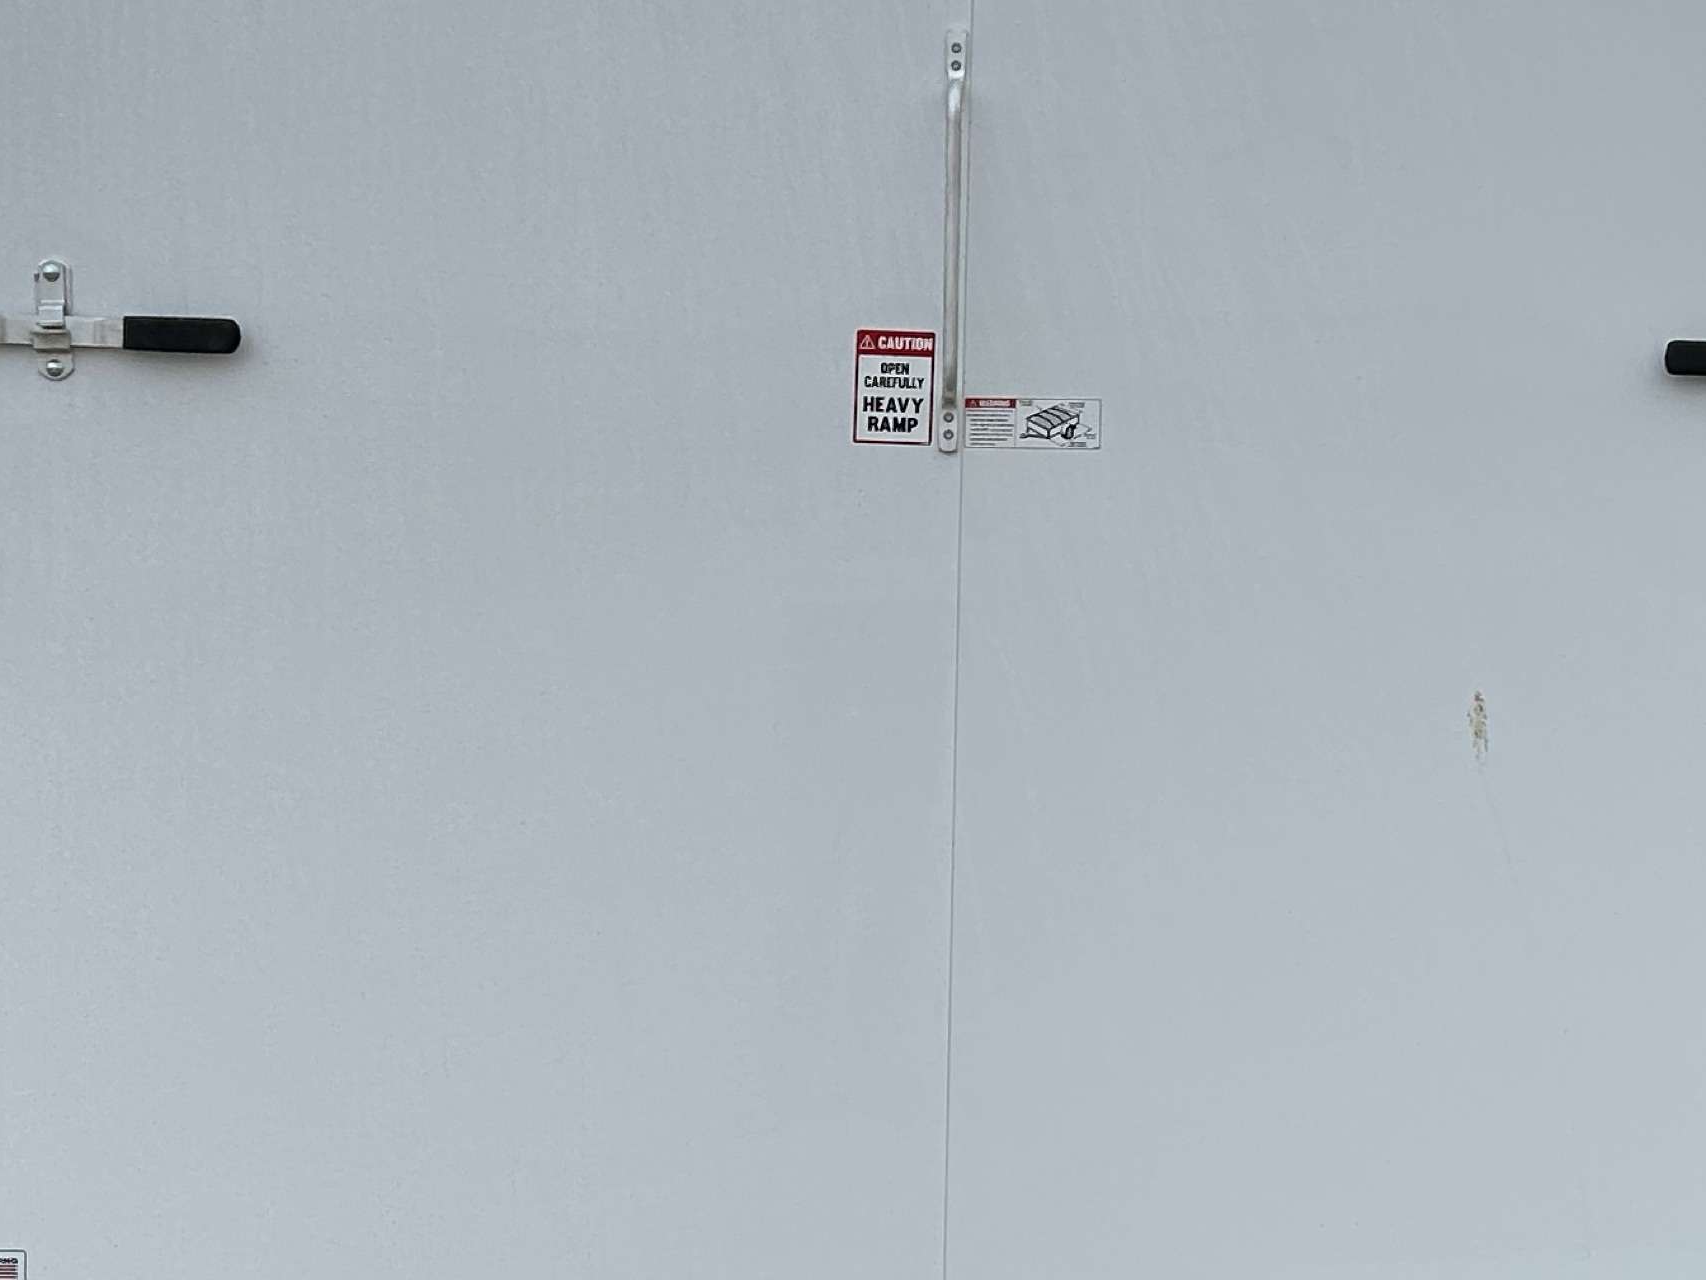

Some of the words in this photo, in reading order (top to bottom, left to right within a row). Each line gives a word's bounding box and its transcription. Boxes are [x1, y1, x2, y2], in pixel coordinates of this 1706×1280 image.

[877, 335, 934, 351] CAUTION
[880, 362, 910, 375] OPEN
[863, 375, 925, 389] CAREFULLY
[862, 395, 925, 414] HEAVY
[867, 416, 919, 433] RAMP
